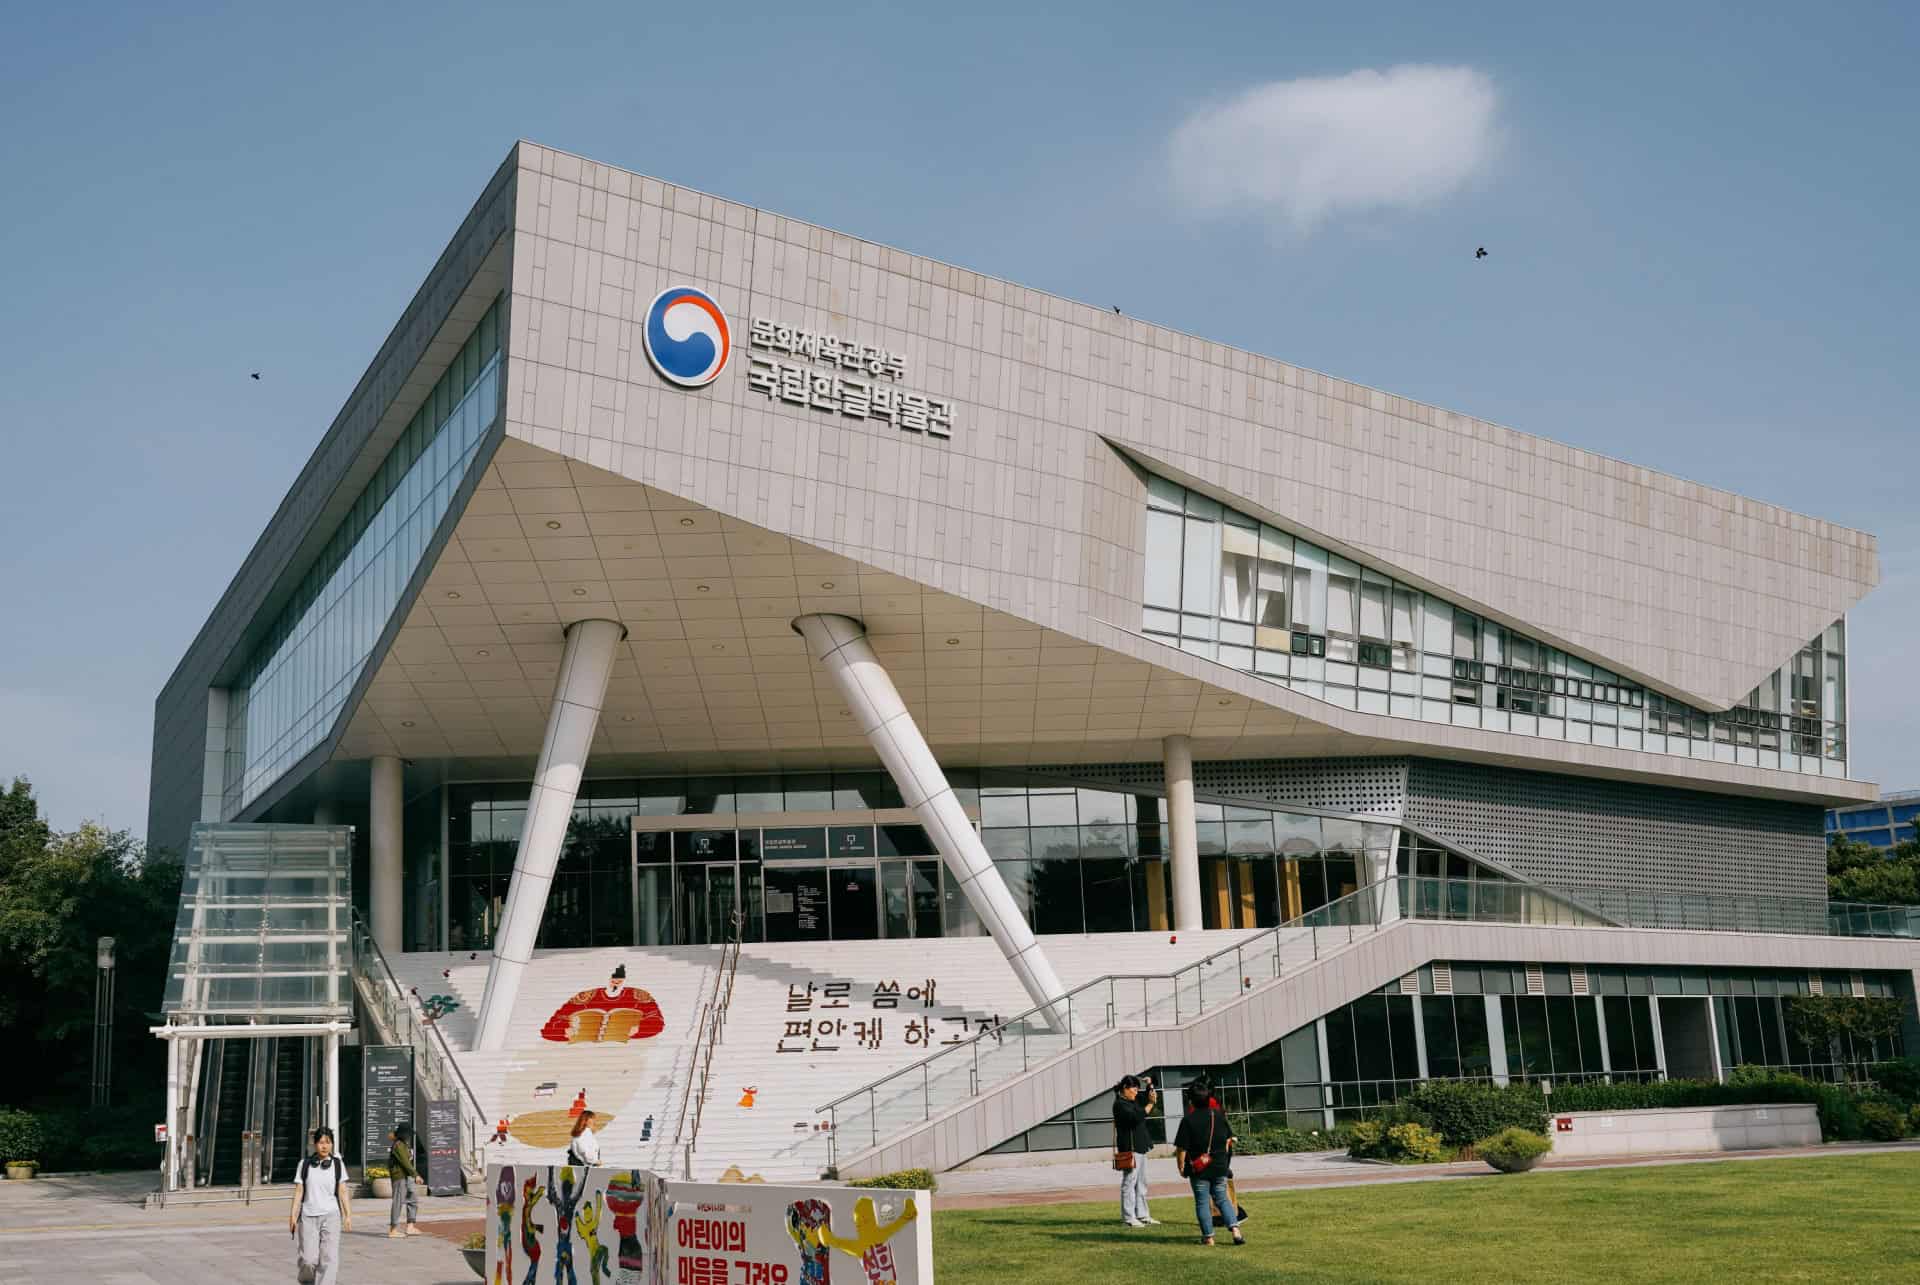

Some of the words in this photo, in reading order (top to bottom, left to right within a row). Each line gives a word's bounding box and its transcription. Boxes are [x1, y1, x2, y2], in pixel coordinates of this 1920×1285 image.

[750, 317, 907, 379] 문화체육관광부
[748, 357, 955, 439] 국립한글박물관
[785, 981, 851, 1012] 날로
[872, 979, 937, 1009] 씀에
[776, 1017, 883, 1052] 편안케
[904, 1014, 1007, 1048] 하고자
[677, 1218, 746, 1253] 어린이의
[677, 1255, 729, 1285] 마음을
